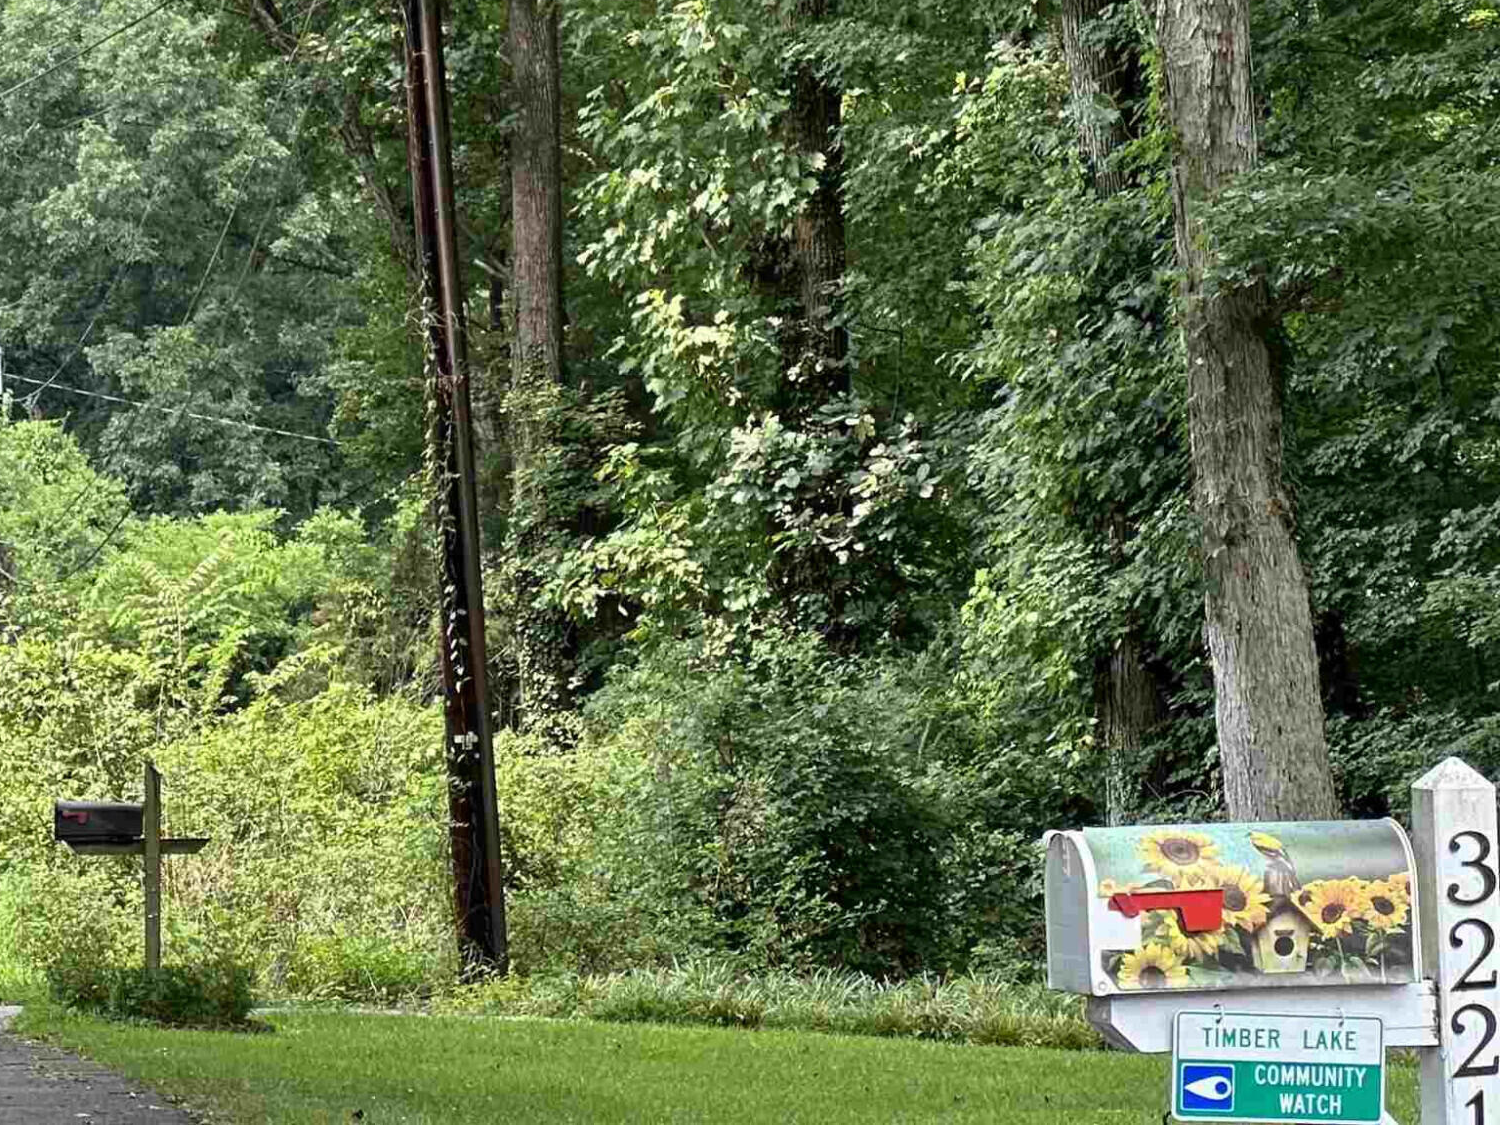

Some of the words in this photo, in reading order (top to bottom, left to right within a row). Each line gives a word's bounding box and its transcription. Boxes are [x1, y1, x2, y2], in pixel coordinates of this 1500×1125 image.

[1202, 1027, 1280, 1049] TIMBER
[1303, 1029, 1357, 1050] LAKE
[1254, 1064, 1367, 1088] COMMUNITY
[1279, 1093, 1342, 1116] WATCH
